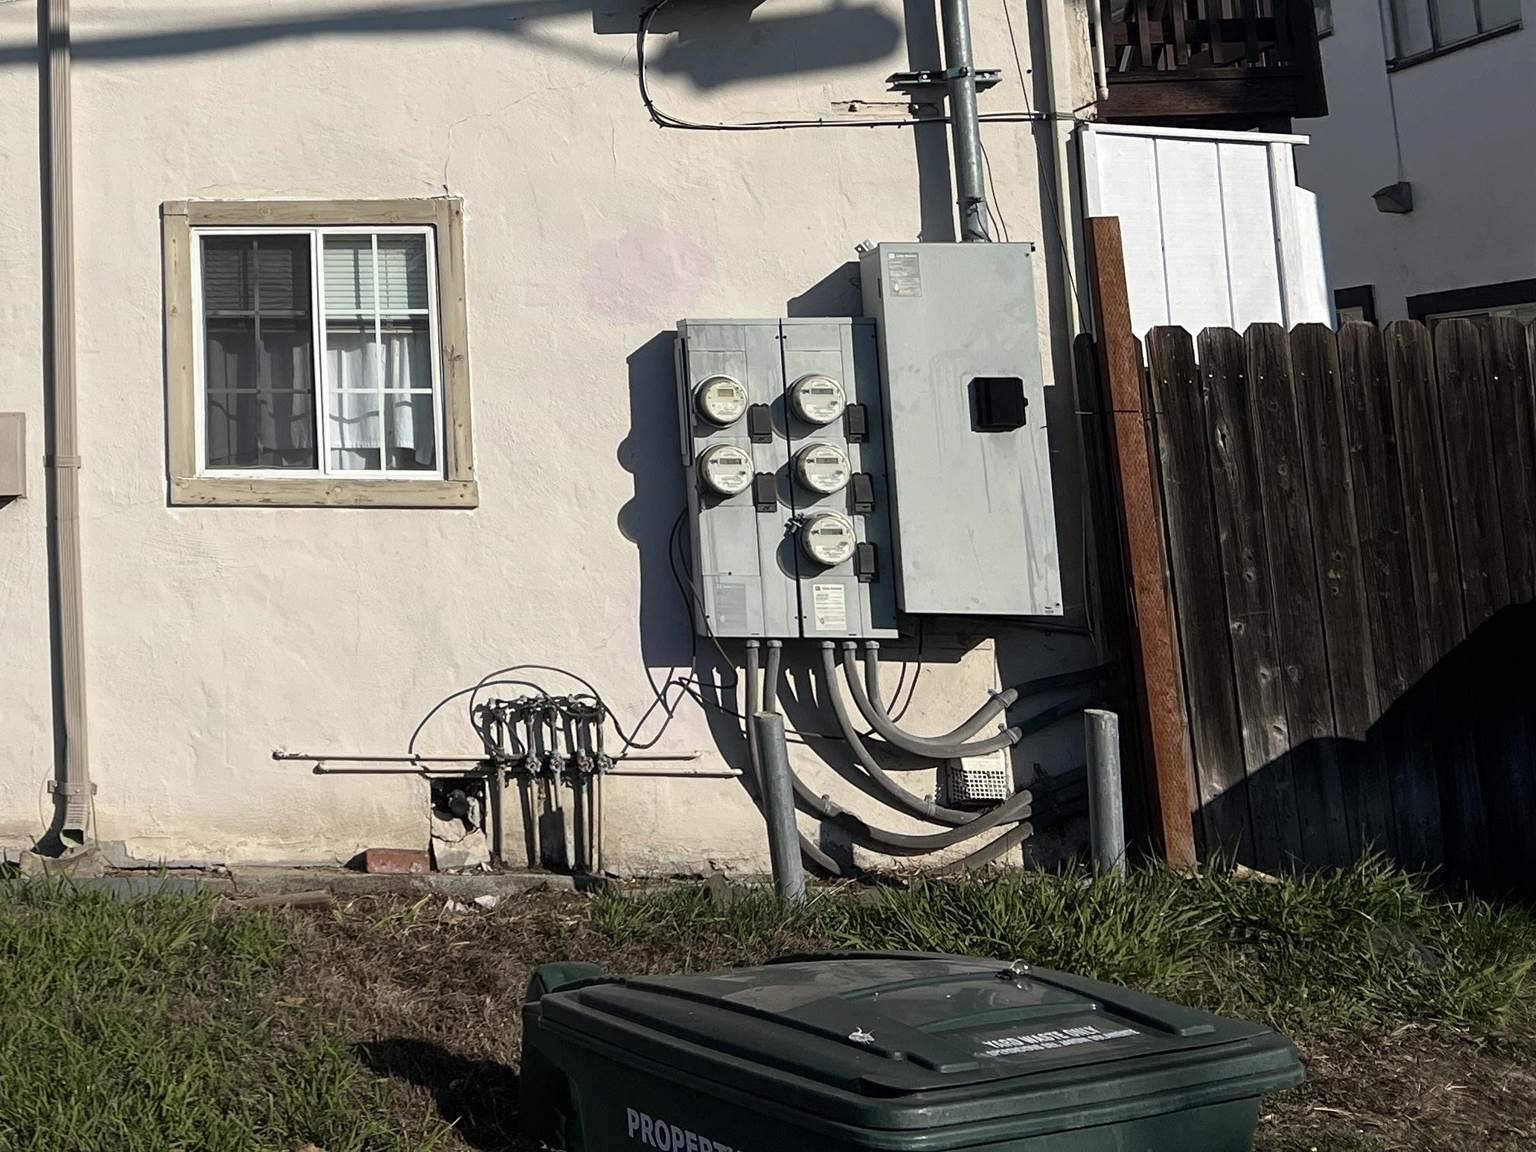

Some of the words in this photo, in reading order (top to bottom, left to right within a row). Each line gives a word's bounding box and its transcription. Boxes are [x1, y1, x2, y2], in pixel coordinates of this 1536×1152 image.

[981, 1037, 1025, 1049] YARD
[1016, 1030, 1071, 1045] WASTE
[1061, 1025, 1102, 1038] ONLY
[626, 1107, 744, 1152] PROPER
